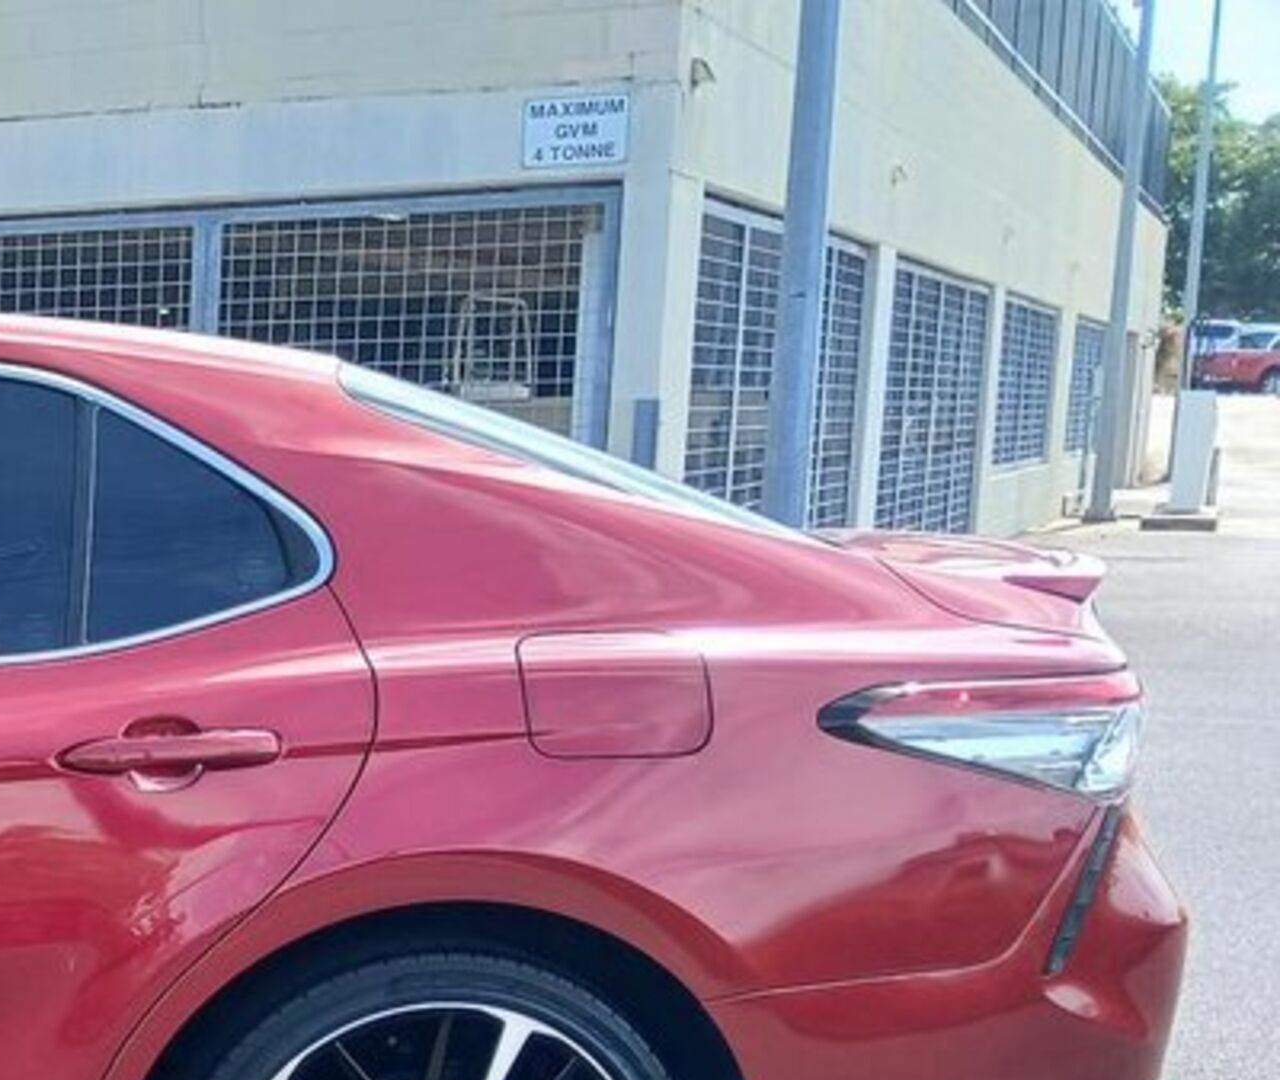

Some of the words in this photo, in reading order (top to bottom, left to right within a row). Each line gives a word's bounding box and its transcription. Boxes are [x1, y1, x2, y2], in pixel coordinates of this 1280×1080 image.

[529, 99, 625, 118] MAXIMUM
[554, 122, 598, 139] GVM
[533, 147, 543, 161] 4
[550, 141, 616, 161] TONNE
